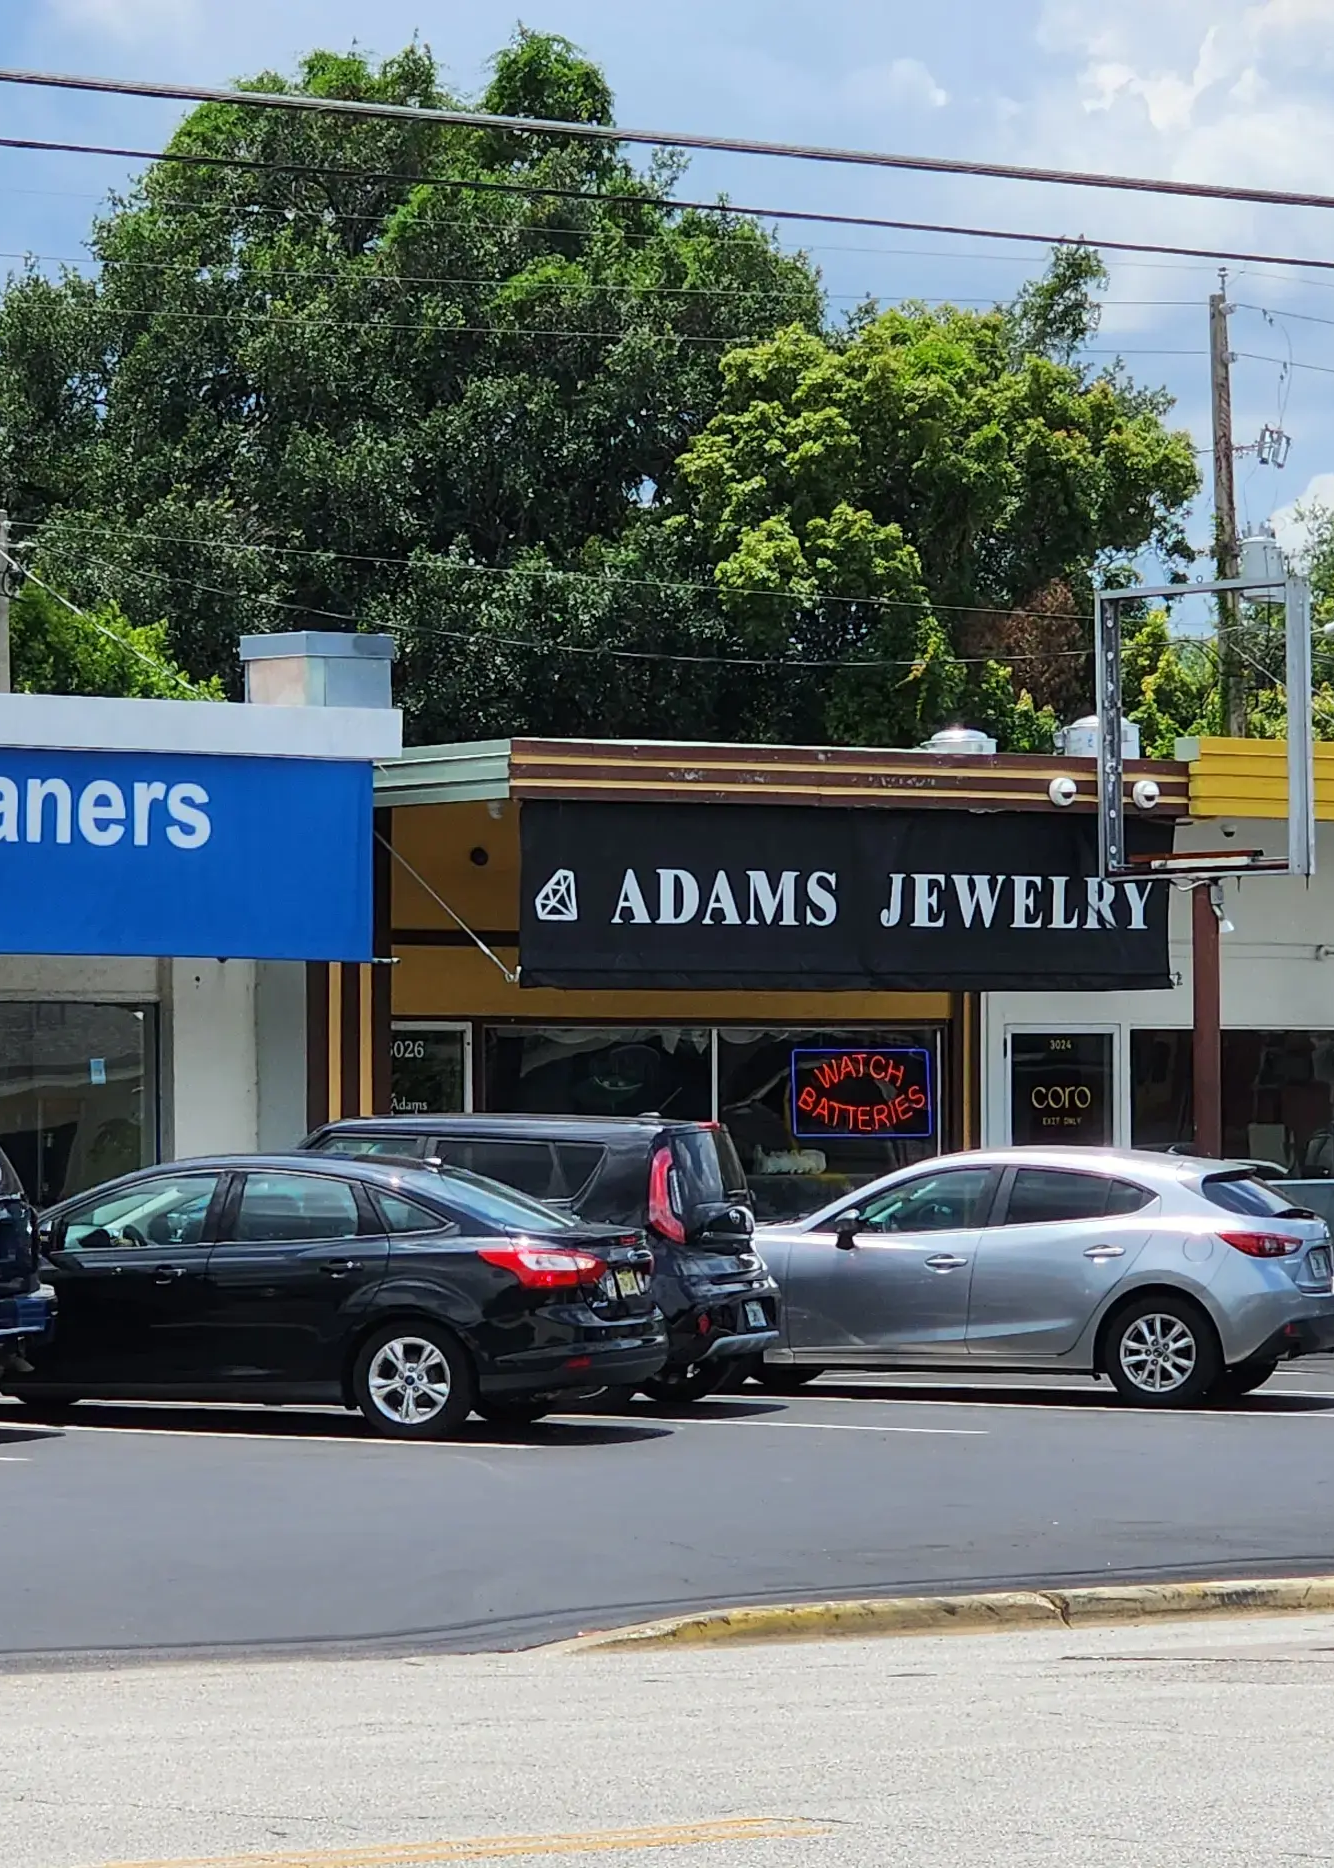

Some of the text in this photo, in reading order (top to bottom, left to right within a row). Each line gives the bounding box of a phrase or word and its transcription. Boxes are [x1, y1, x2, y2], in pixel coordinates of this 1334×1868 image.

[610, 868, 1154, 930] ADAMS JEWELRY
[1049, 1039, 1072, 1050] 3024
[814, 1054, 904, 1089] WATCH
[797, 1085, 926, 1130] BATTERIES
[1031, 1086, 1091, 1108] coro
